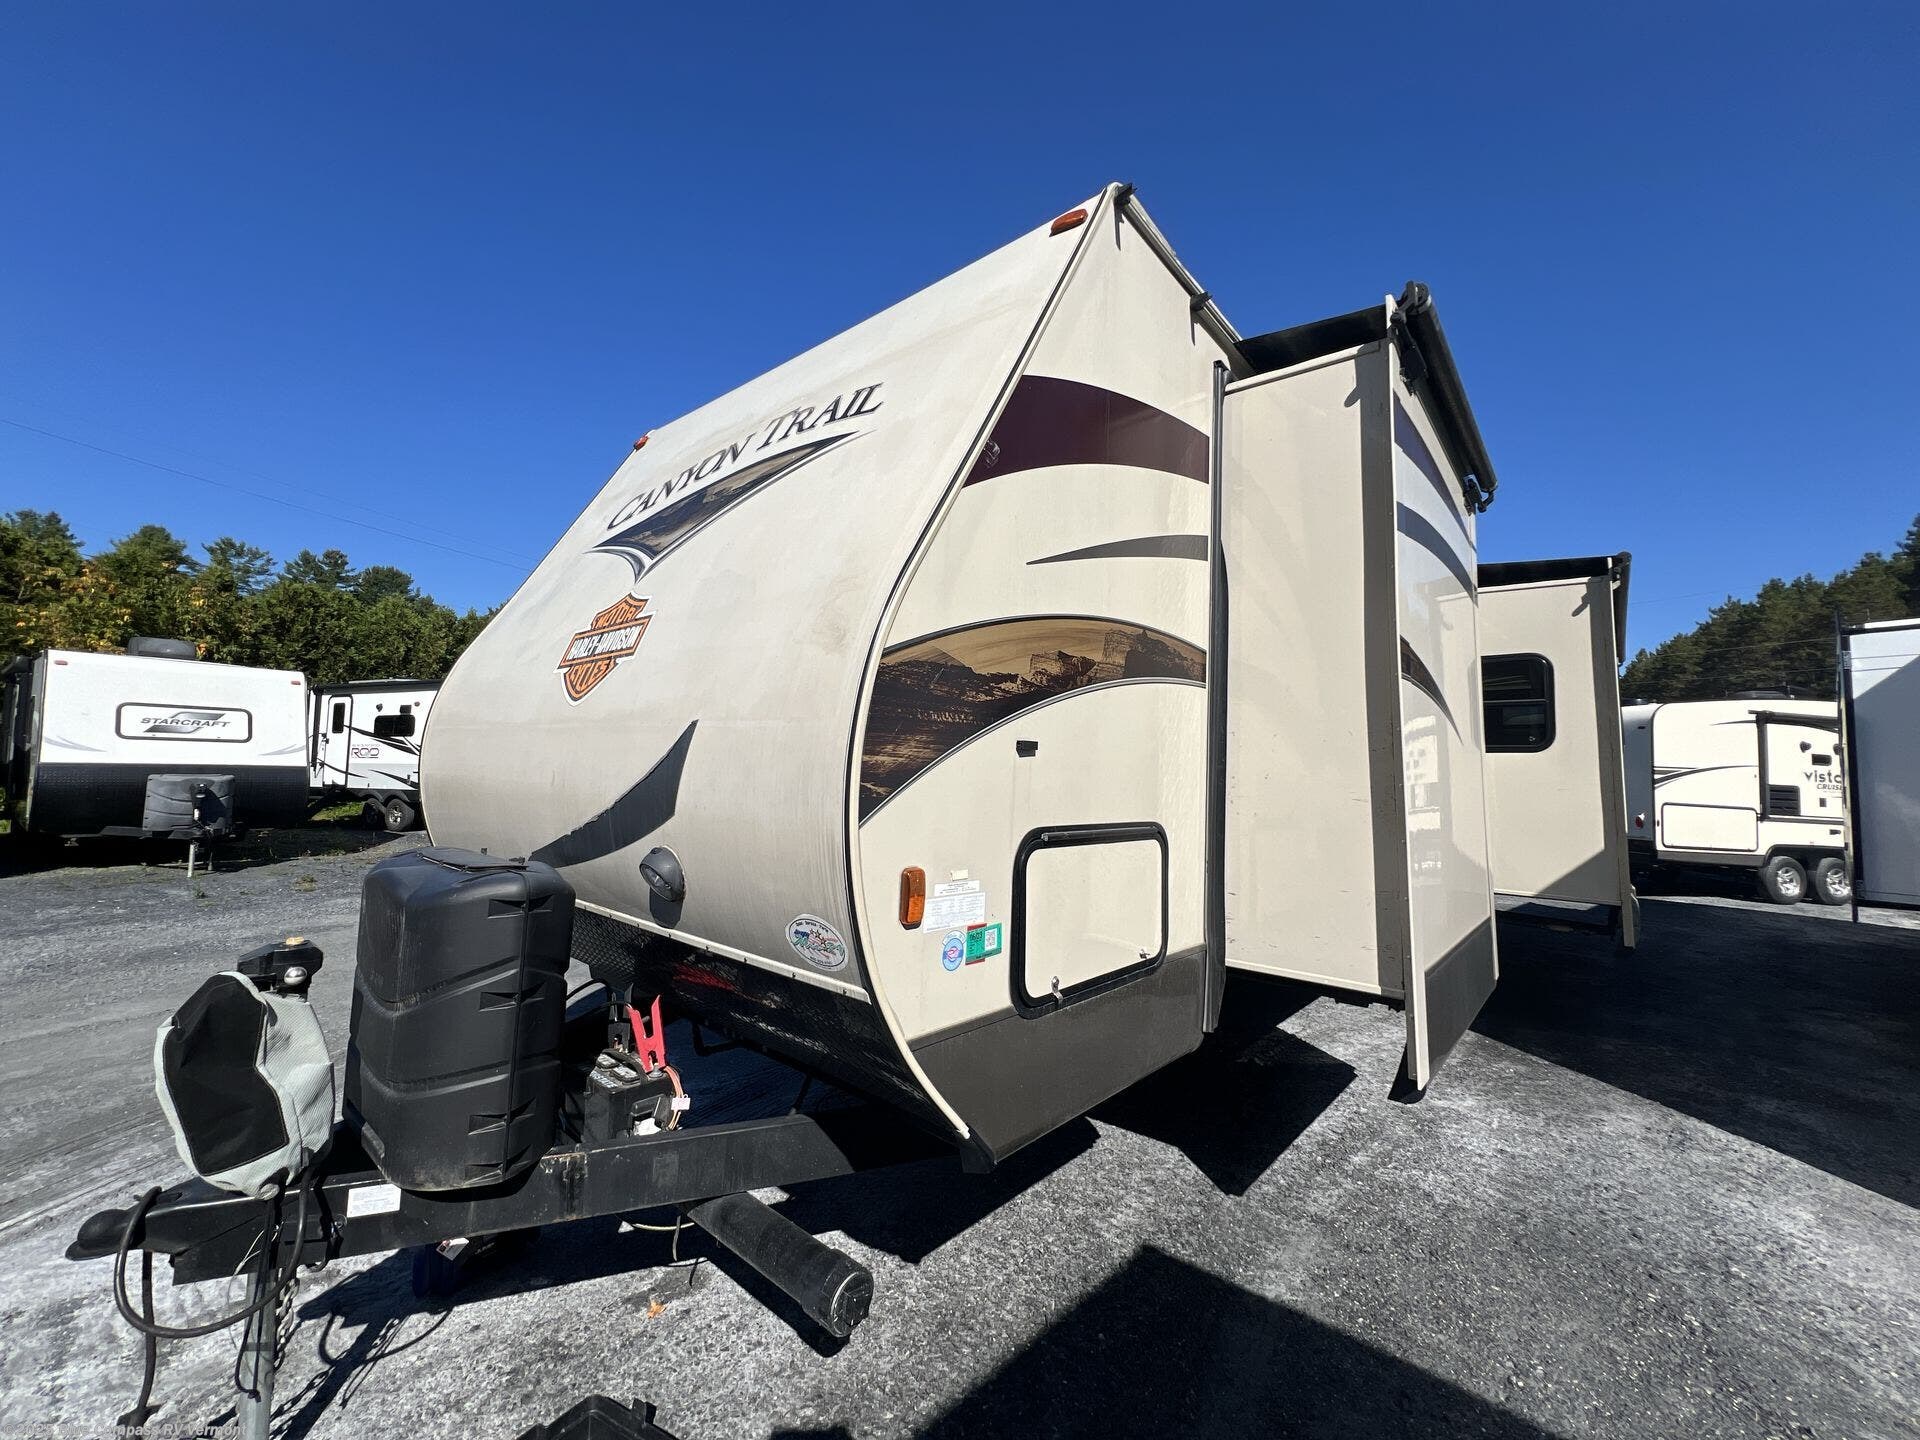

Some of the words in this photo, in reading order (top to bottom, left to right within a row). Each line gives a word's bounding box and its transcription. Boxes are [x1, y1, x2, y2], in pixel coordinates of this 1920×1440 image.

[607, 432, 757, 531] CANYON
[756, 382, 884, 451] TRAIL
[141, 717, 231, 728] STARCRAFT
